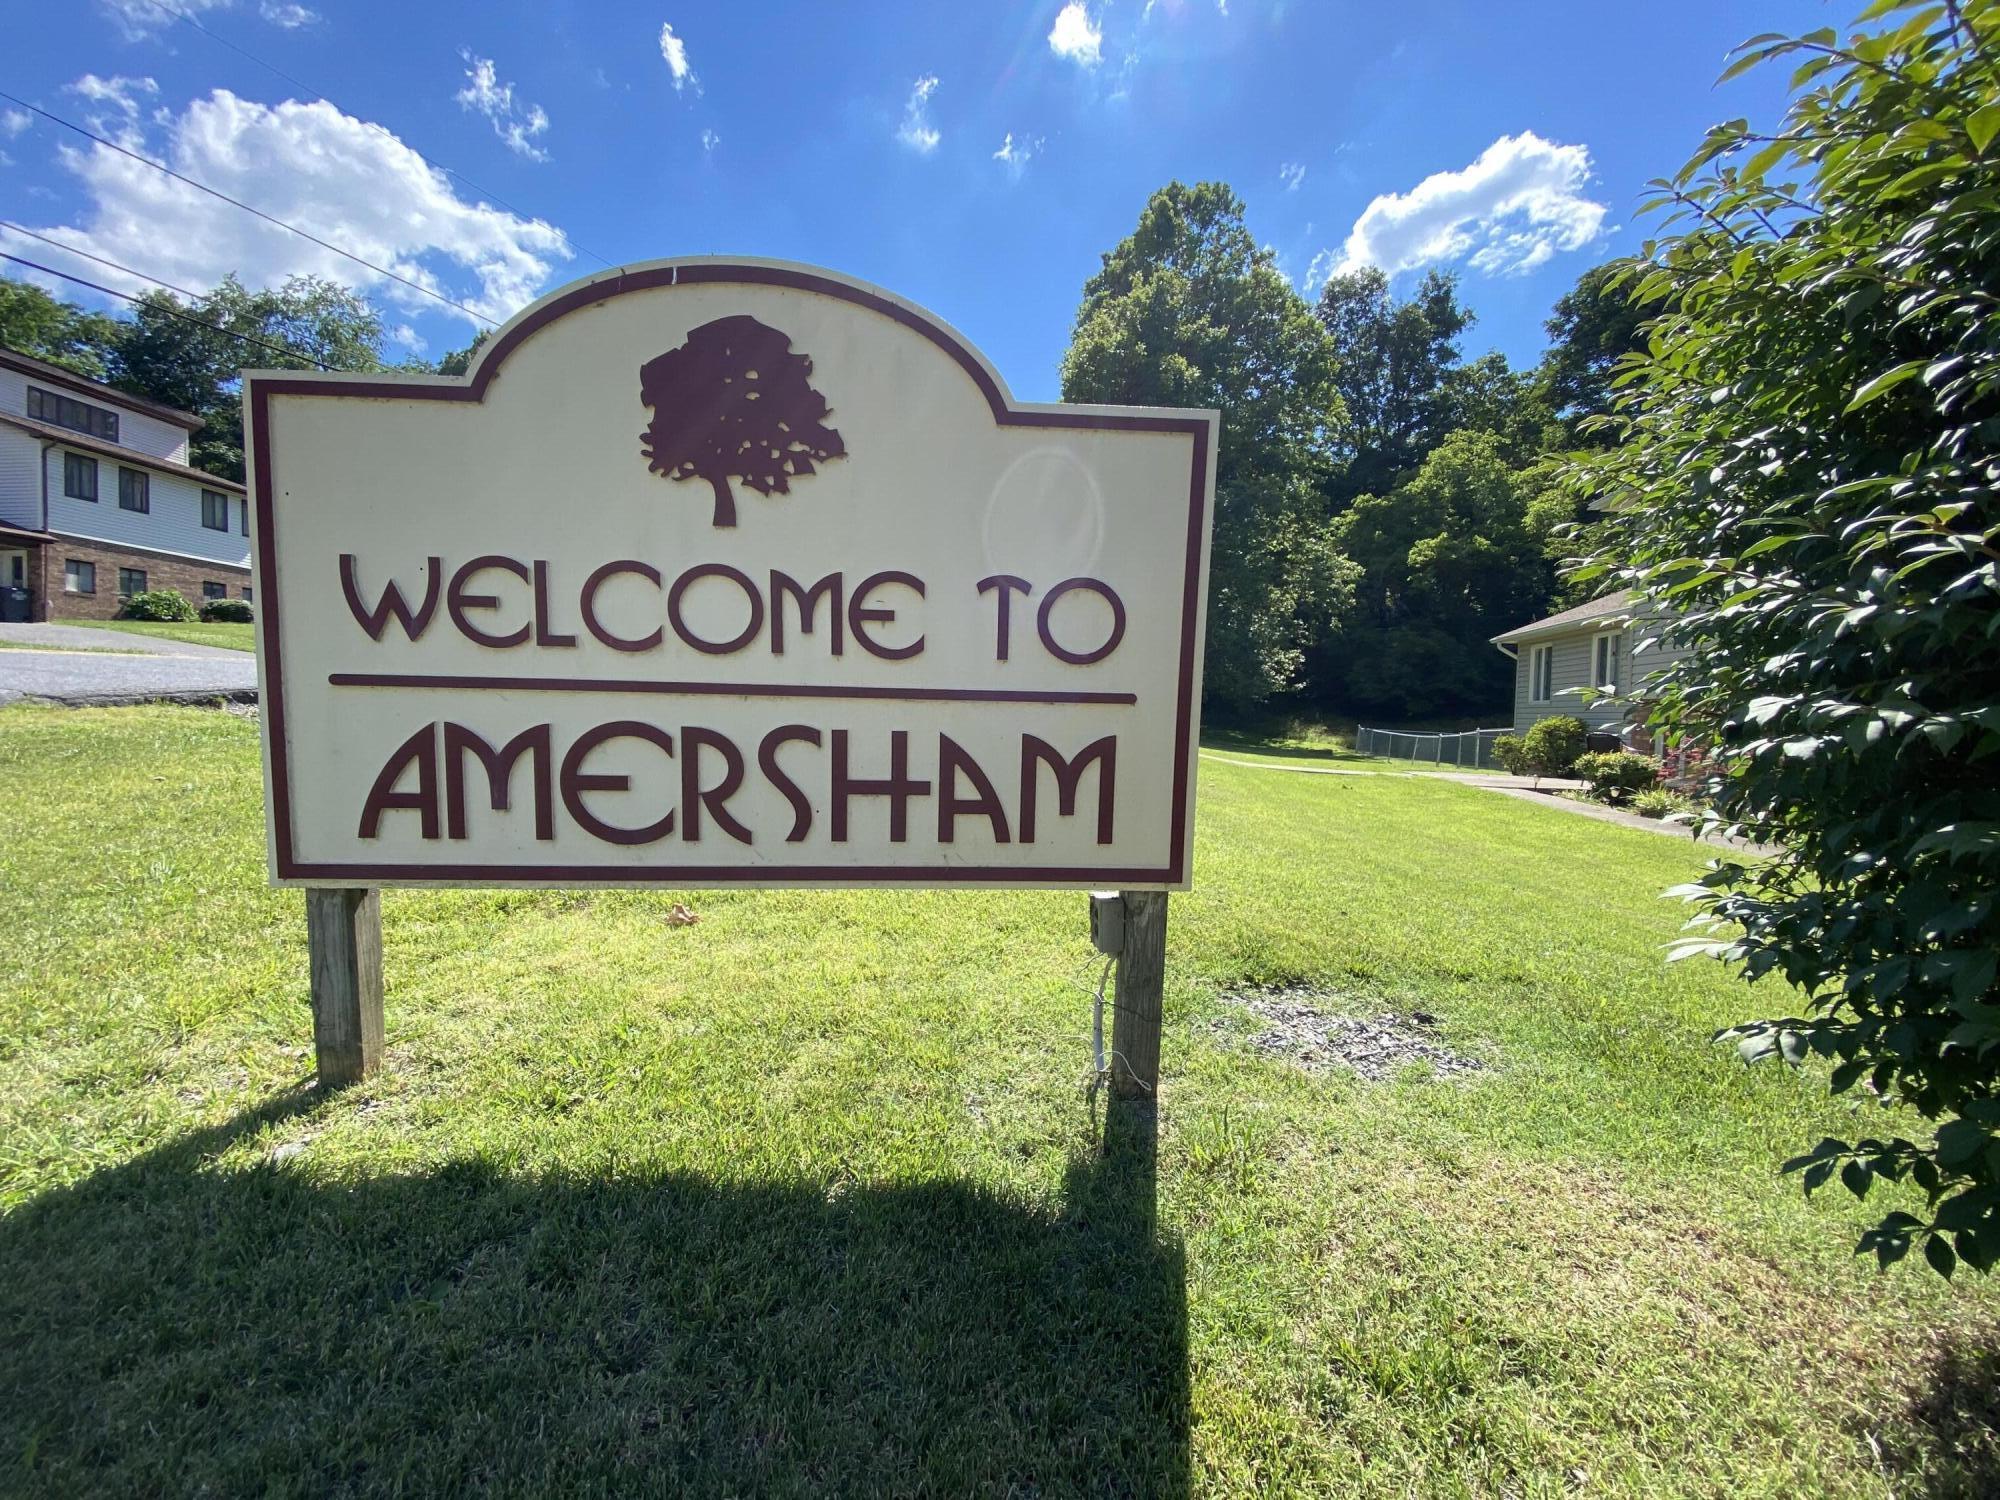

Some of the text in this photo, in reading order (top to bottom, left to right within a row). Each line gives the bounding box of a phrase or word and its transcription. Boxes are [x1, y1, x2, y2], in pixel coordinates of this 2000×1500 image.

[338, 553, 1127, 667] WELCOME TO
[357, 720, 1117, 847] AMERSHAM
